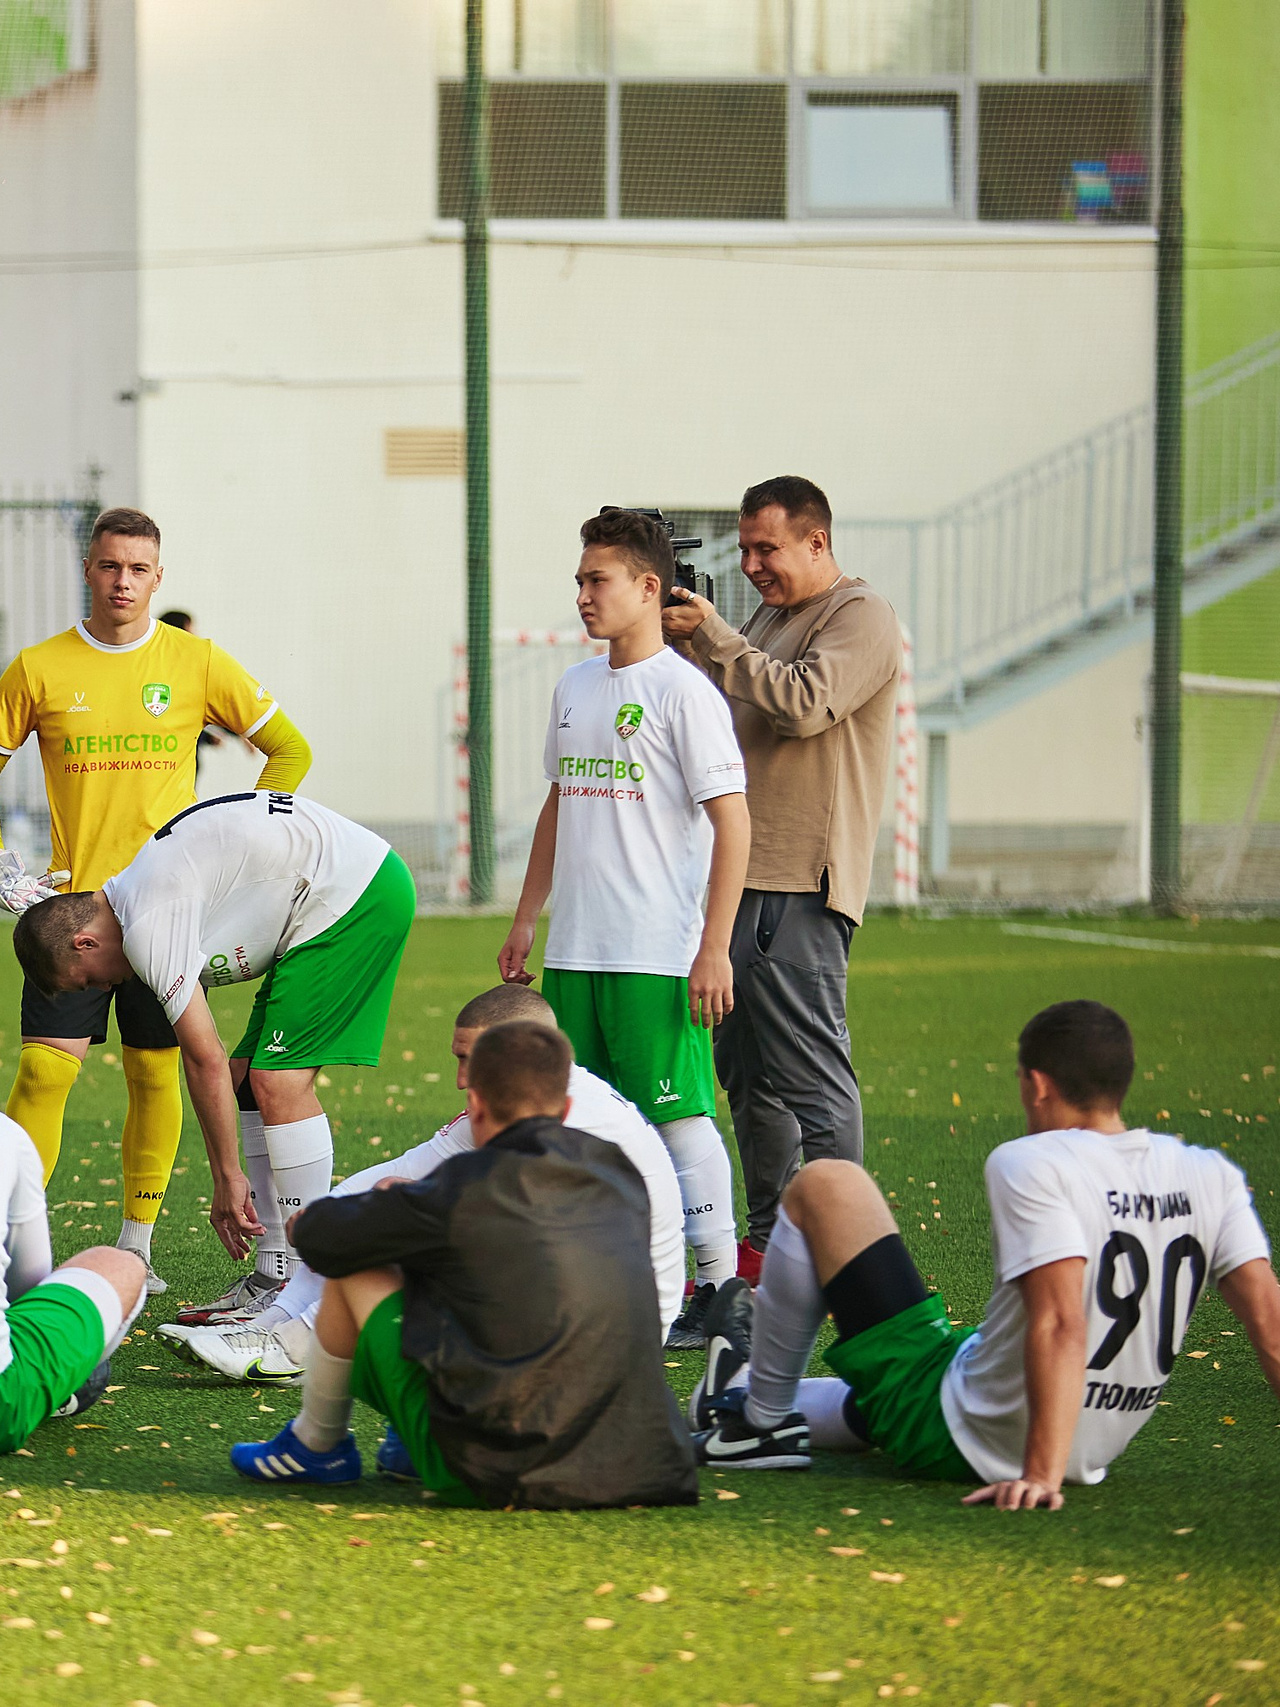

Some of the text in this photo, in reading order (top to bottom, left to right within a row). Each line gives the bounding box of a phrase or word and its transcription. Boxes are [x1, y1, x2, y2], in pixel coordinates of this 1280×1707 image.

[63, 734, 178, 755] АГЕНТСТВО
[65, 760, 176, 774] недвижимости
[558, 756, 645, 782] ГЕНТСТВО
[134, 1190, 165, 1201] JAKO
[1086, 1231, 1207, 1376] 90
[1083, 1381, 1164, 1412] ТЮМЕ
